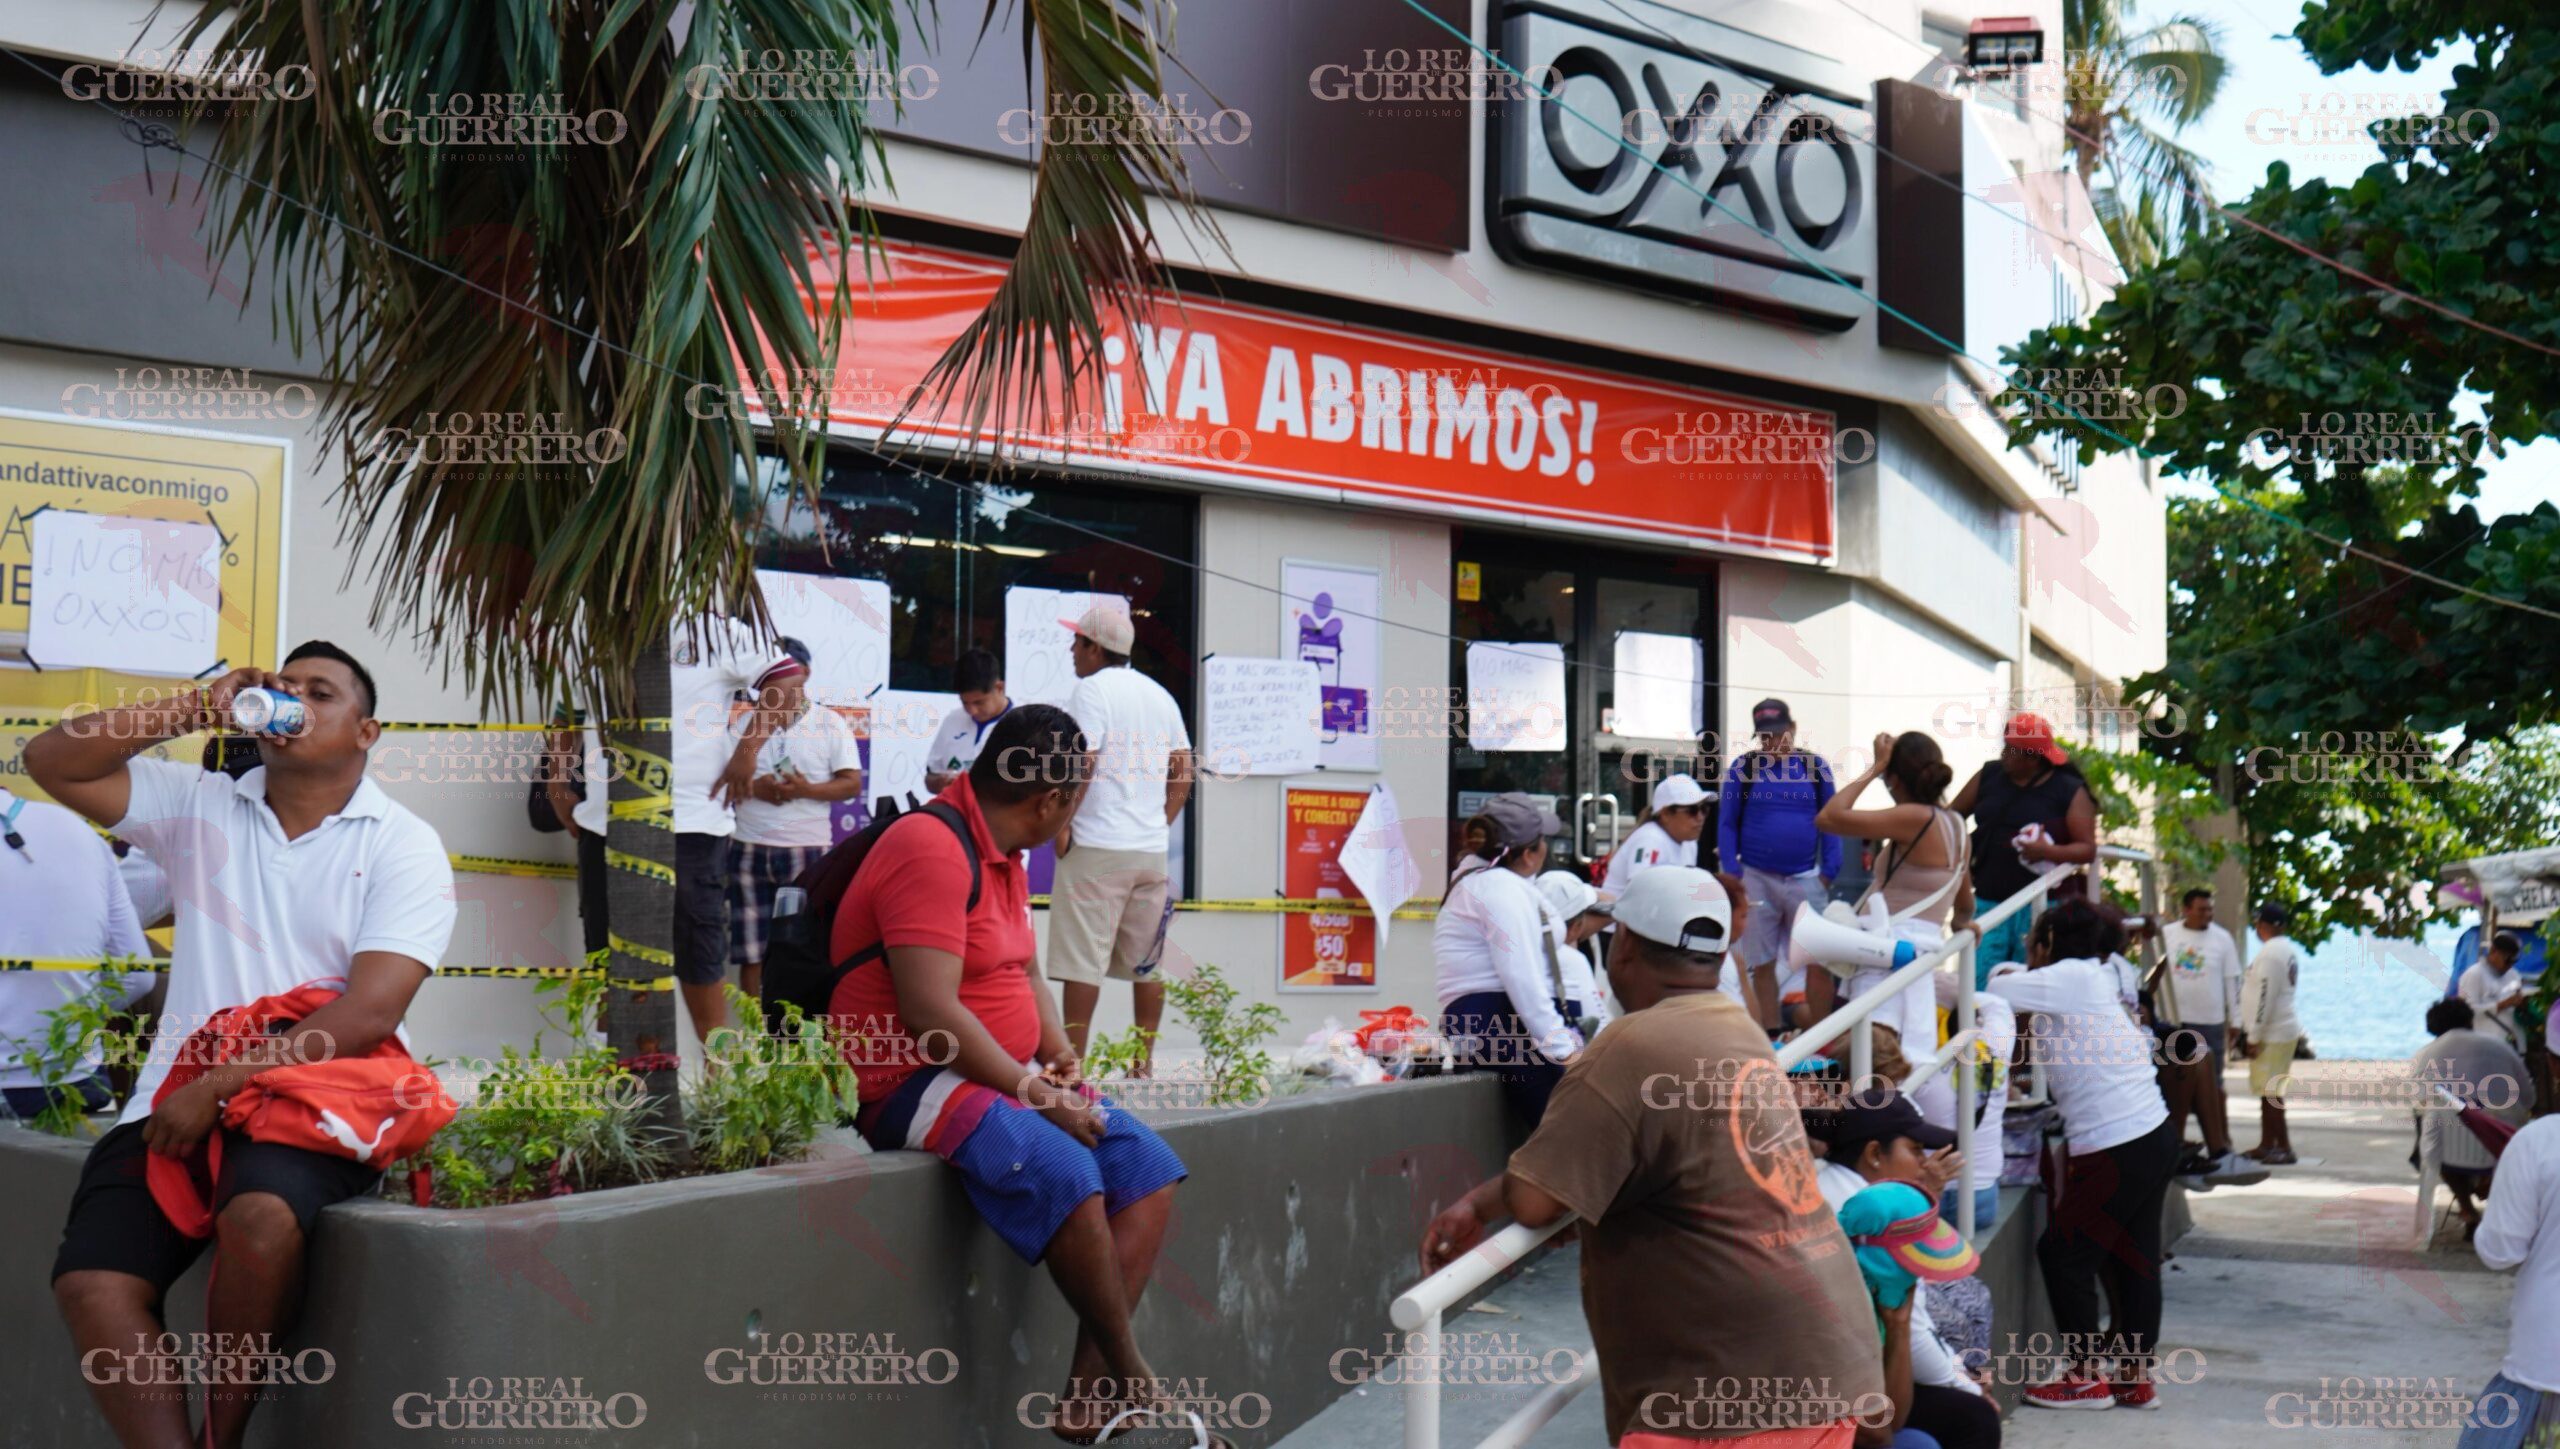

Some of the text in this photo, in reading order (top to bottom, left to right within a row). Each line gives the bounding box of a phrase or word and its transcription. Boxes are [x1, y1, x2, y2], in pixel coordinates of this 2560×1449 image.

[1542, 46, 1862, 251] OXXO
[1256, 345, 1599, 486] ABRIMOS!
[53, 591, 208, 644] OXXOS!
